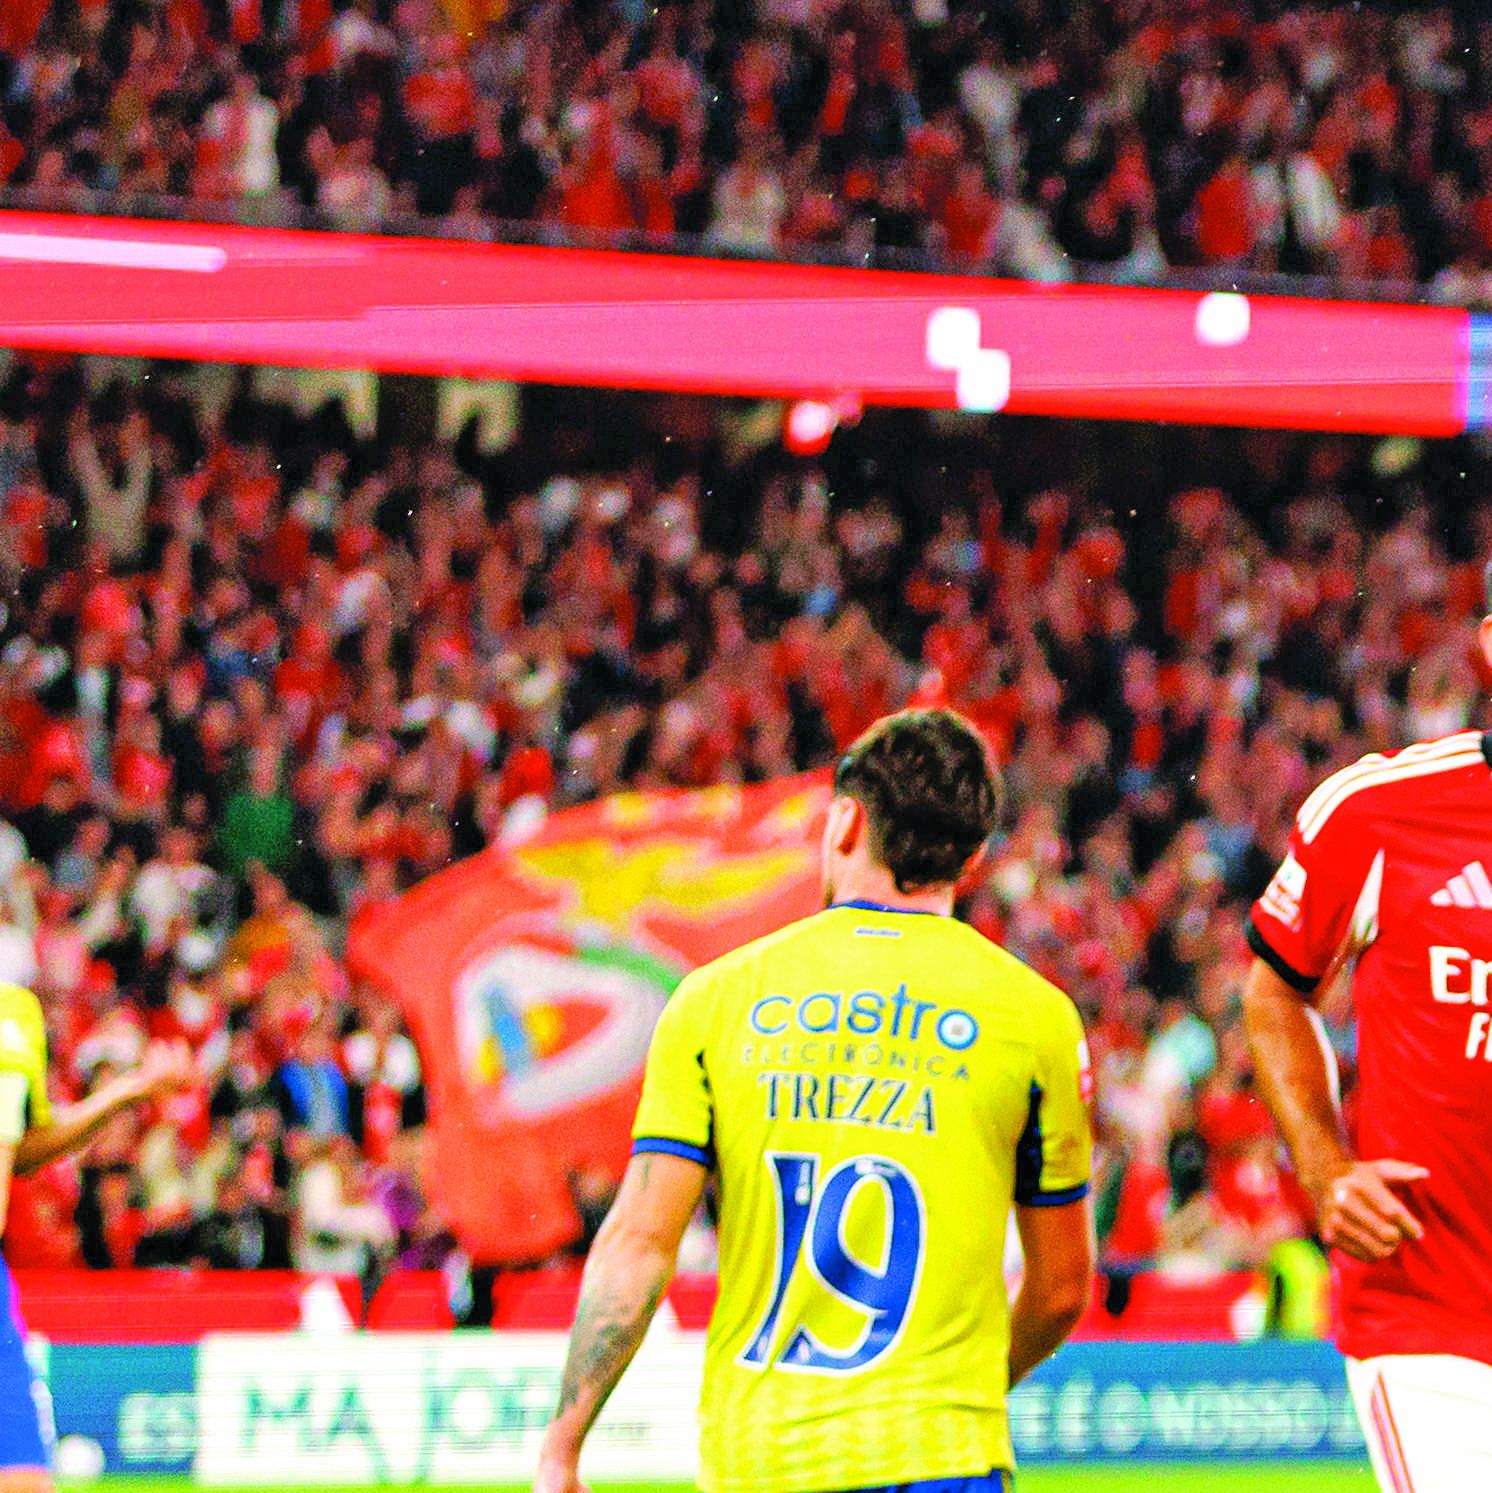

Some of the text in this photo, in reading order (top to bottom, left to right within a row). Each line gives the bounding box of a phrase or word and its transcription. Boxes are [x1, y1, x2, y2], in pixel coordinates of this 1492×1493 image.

[750, 984, 979, 1051] castro
[757, 1072, 938, 1134] TREZZA
[735, 1150, 928, 1377] 19
